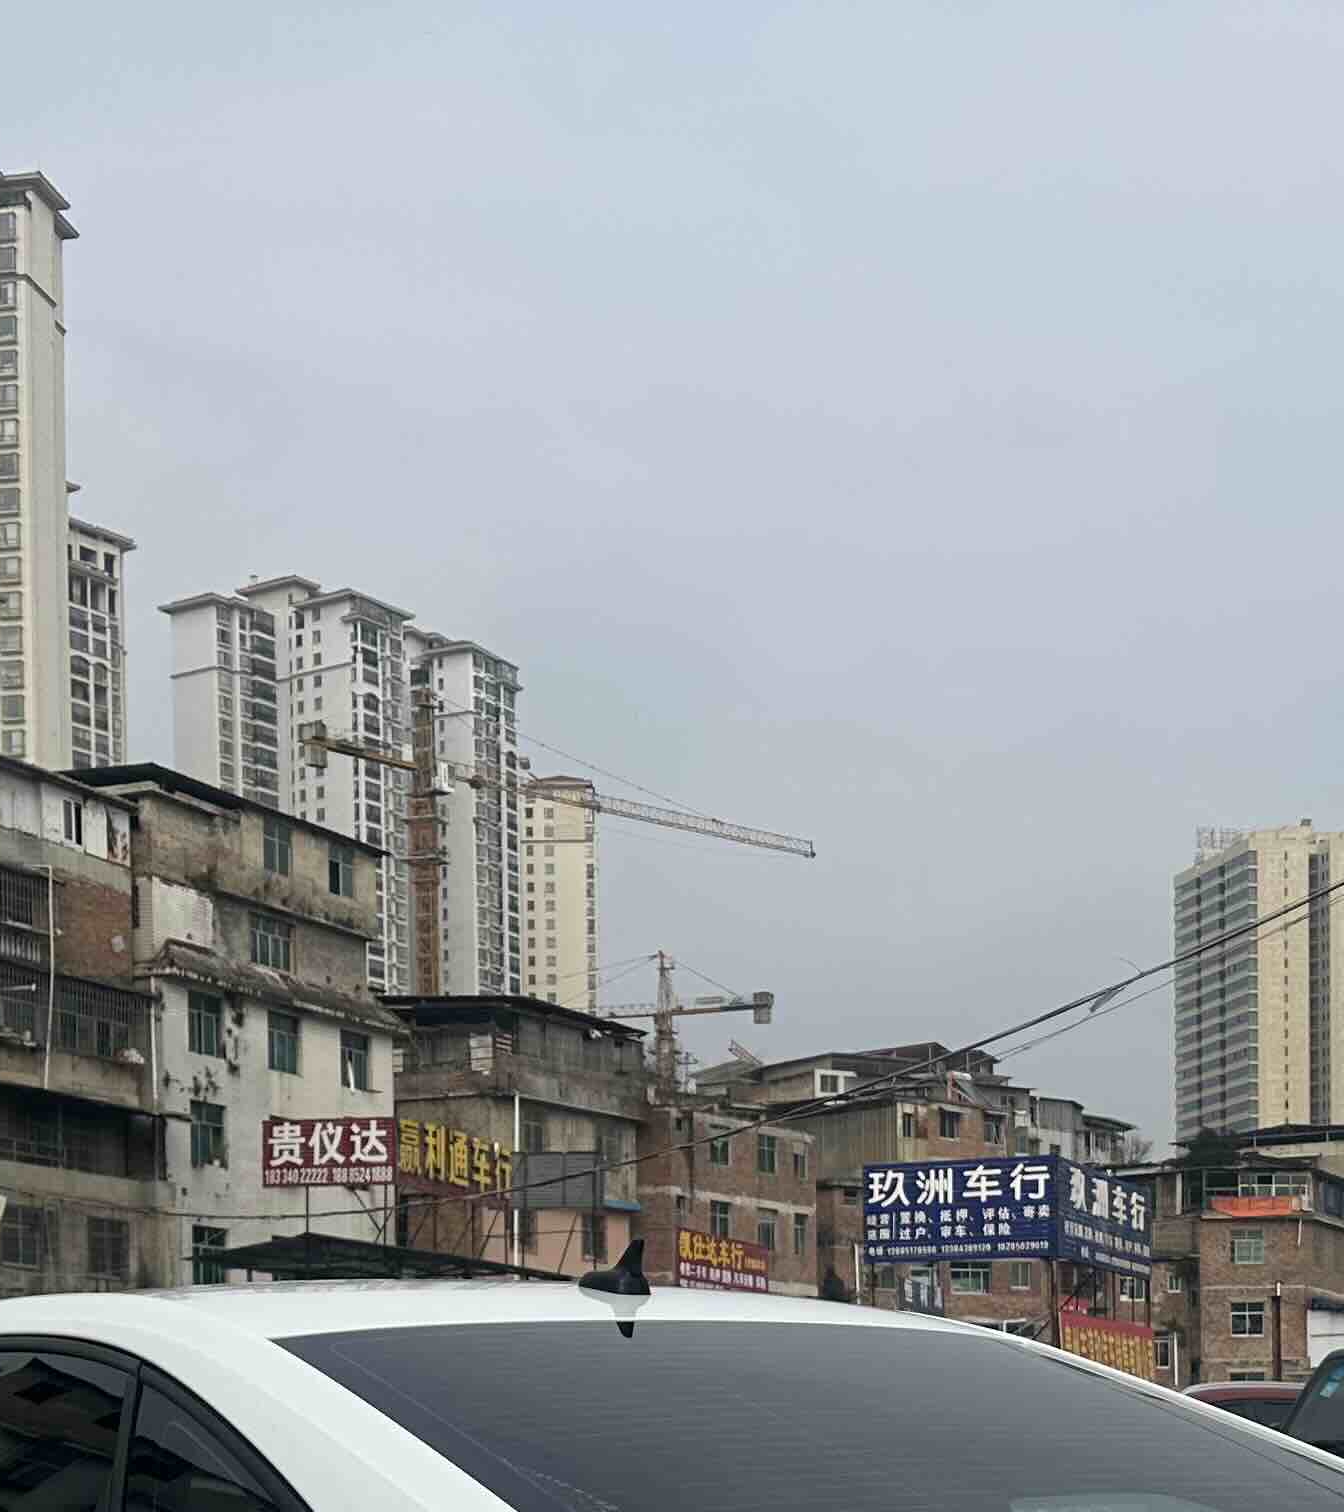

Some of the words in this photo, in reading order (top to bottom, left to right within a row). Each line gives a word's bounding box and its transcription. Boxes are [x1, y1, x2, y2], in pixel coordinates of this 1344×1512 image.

[268, 1120, 389, 1167] 贵仪达
[868, 1163, 1051, 1208] 玖洲车行
